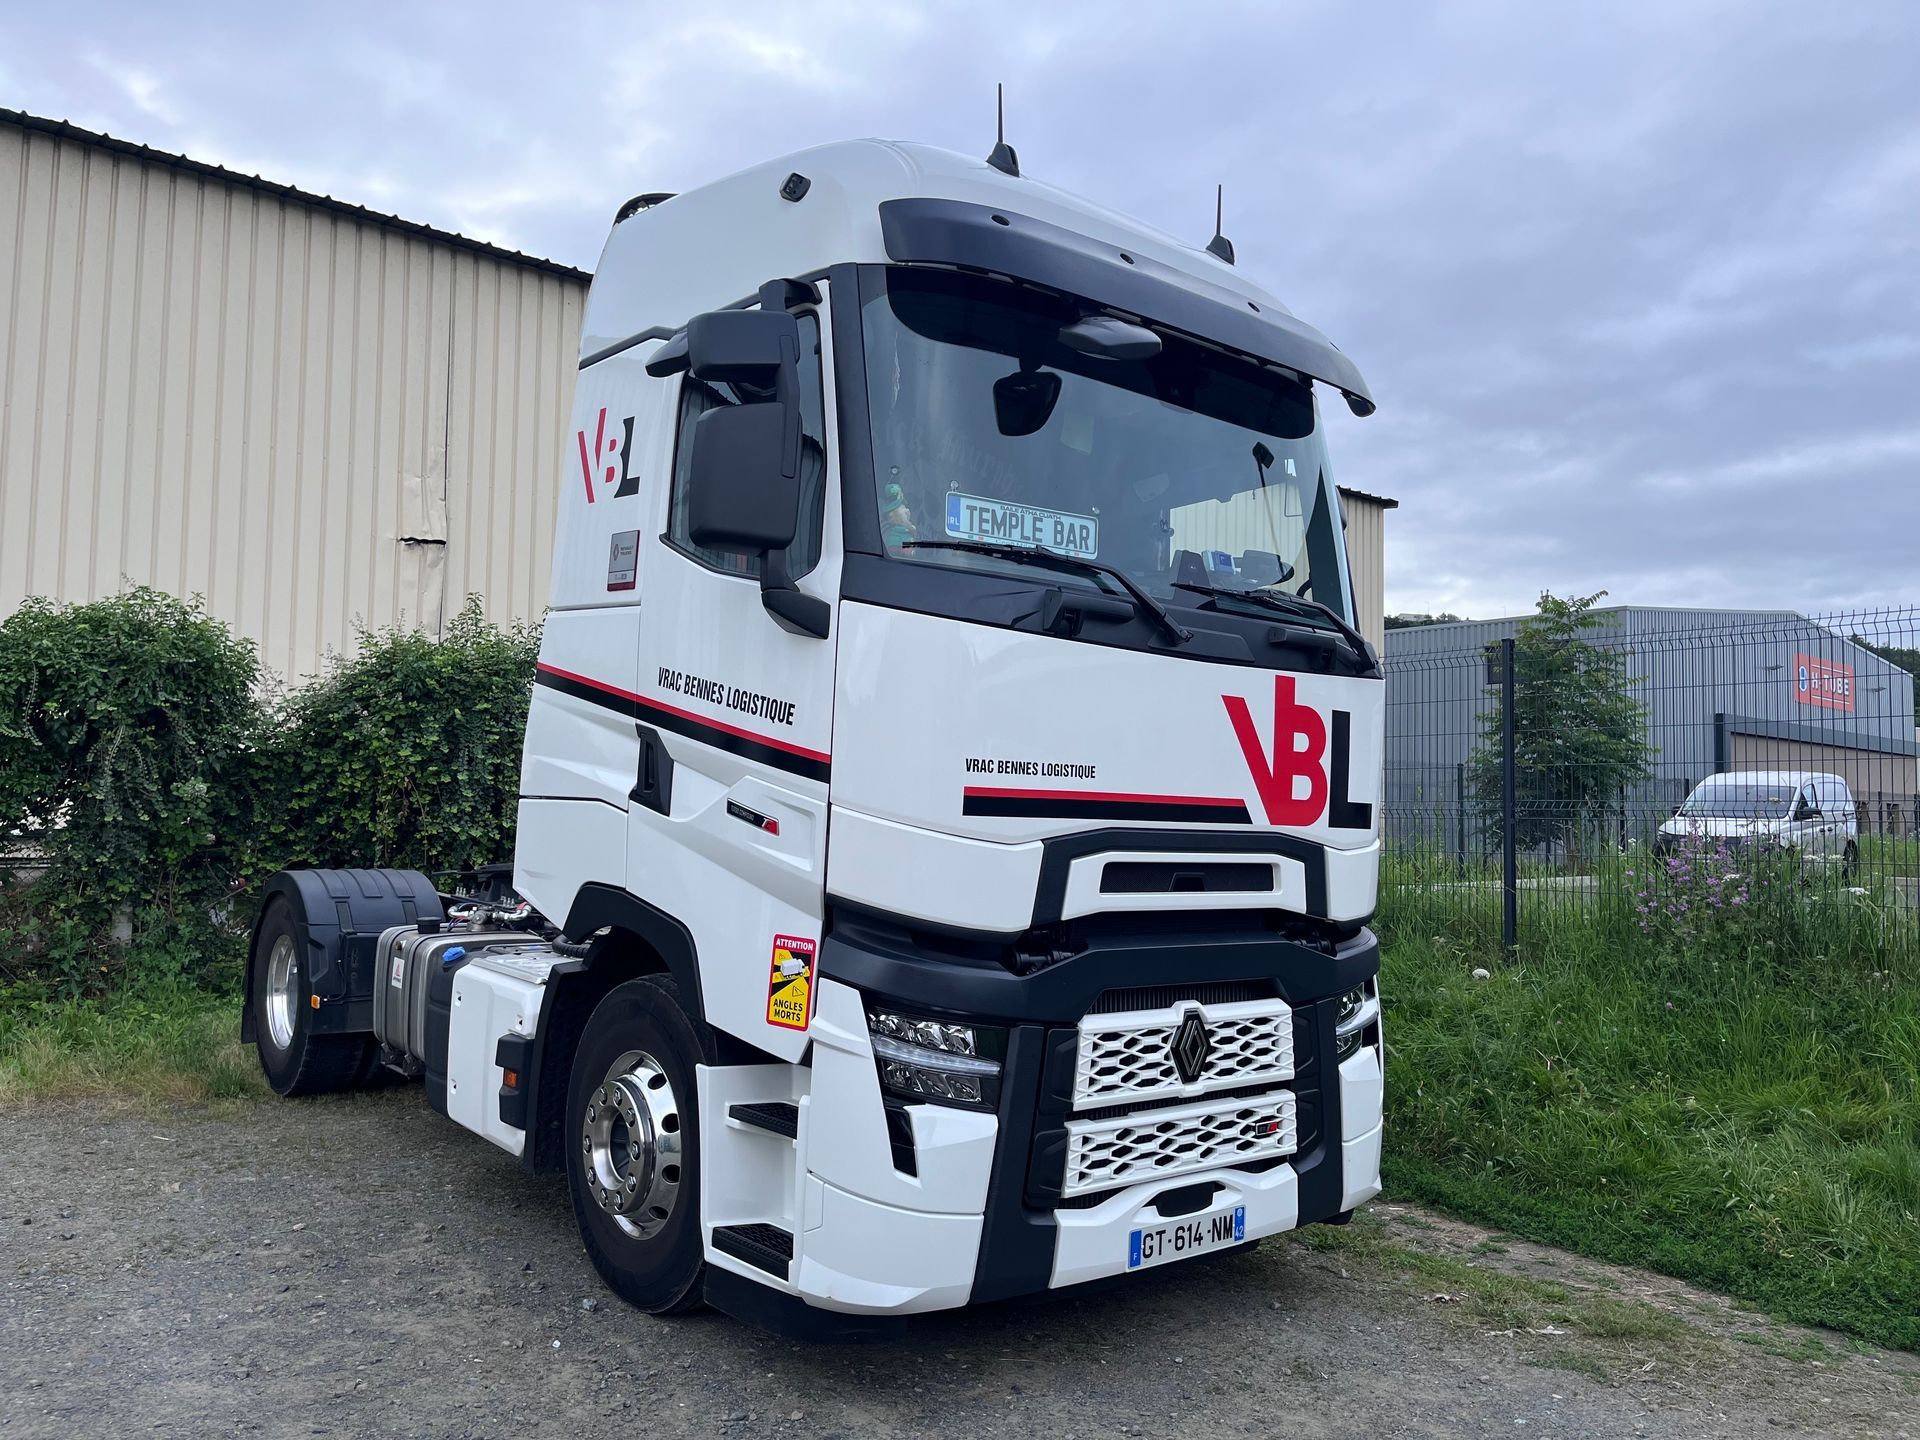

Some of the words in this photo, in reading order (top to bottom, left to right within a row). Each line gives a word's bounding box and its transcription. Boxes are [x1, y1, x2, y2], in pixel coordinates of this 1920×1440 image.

[577, 407, 641, 503] VBL
[966, 505, 1043, 543] TEMPLE
[1053, 519, 1090, 551] BAR
[658, 666, 682, 693] VRAC
[683, 674, 725, 705] BENNES
[726, 686, 796, 726] LOGISTIQUE
[1221, 674, 1372, 829] VBL
[965, 757, 994, 775] VRAC
[997, 760, 1039, 777] BENNES
[1041, 762, 1096, 780] LOGISTIQUE
[776, 938, 814, 951] ATTENTION
[773, 998, 803, 1012] ANGLES
[774, 1008, 801, 1022] MORTS
[1235, 1225, 1244, 1237] 42
[1133, 1252, 1138, 1261] F
